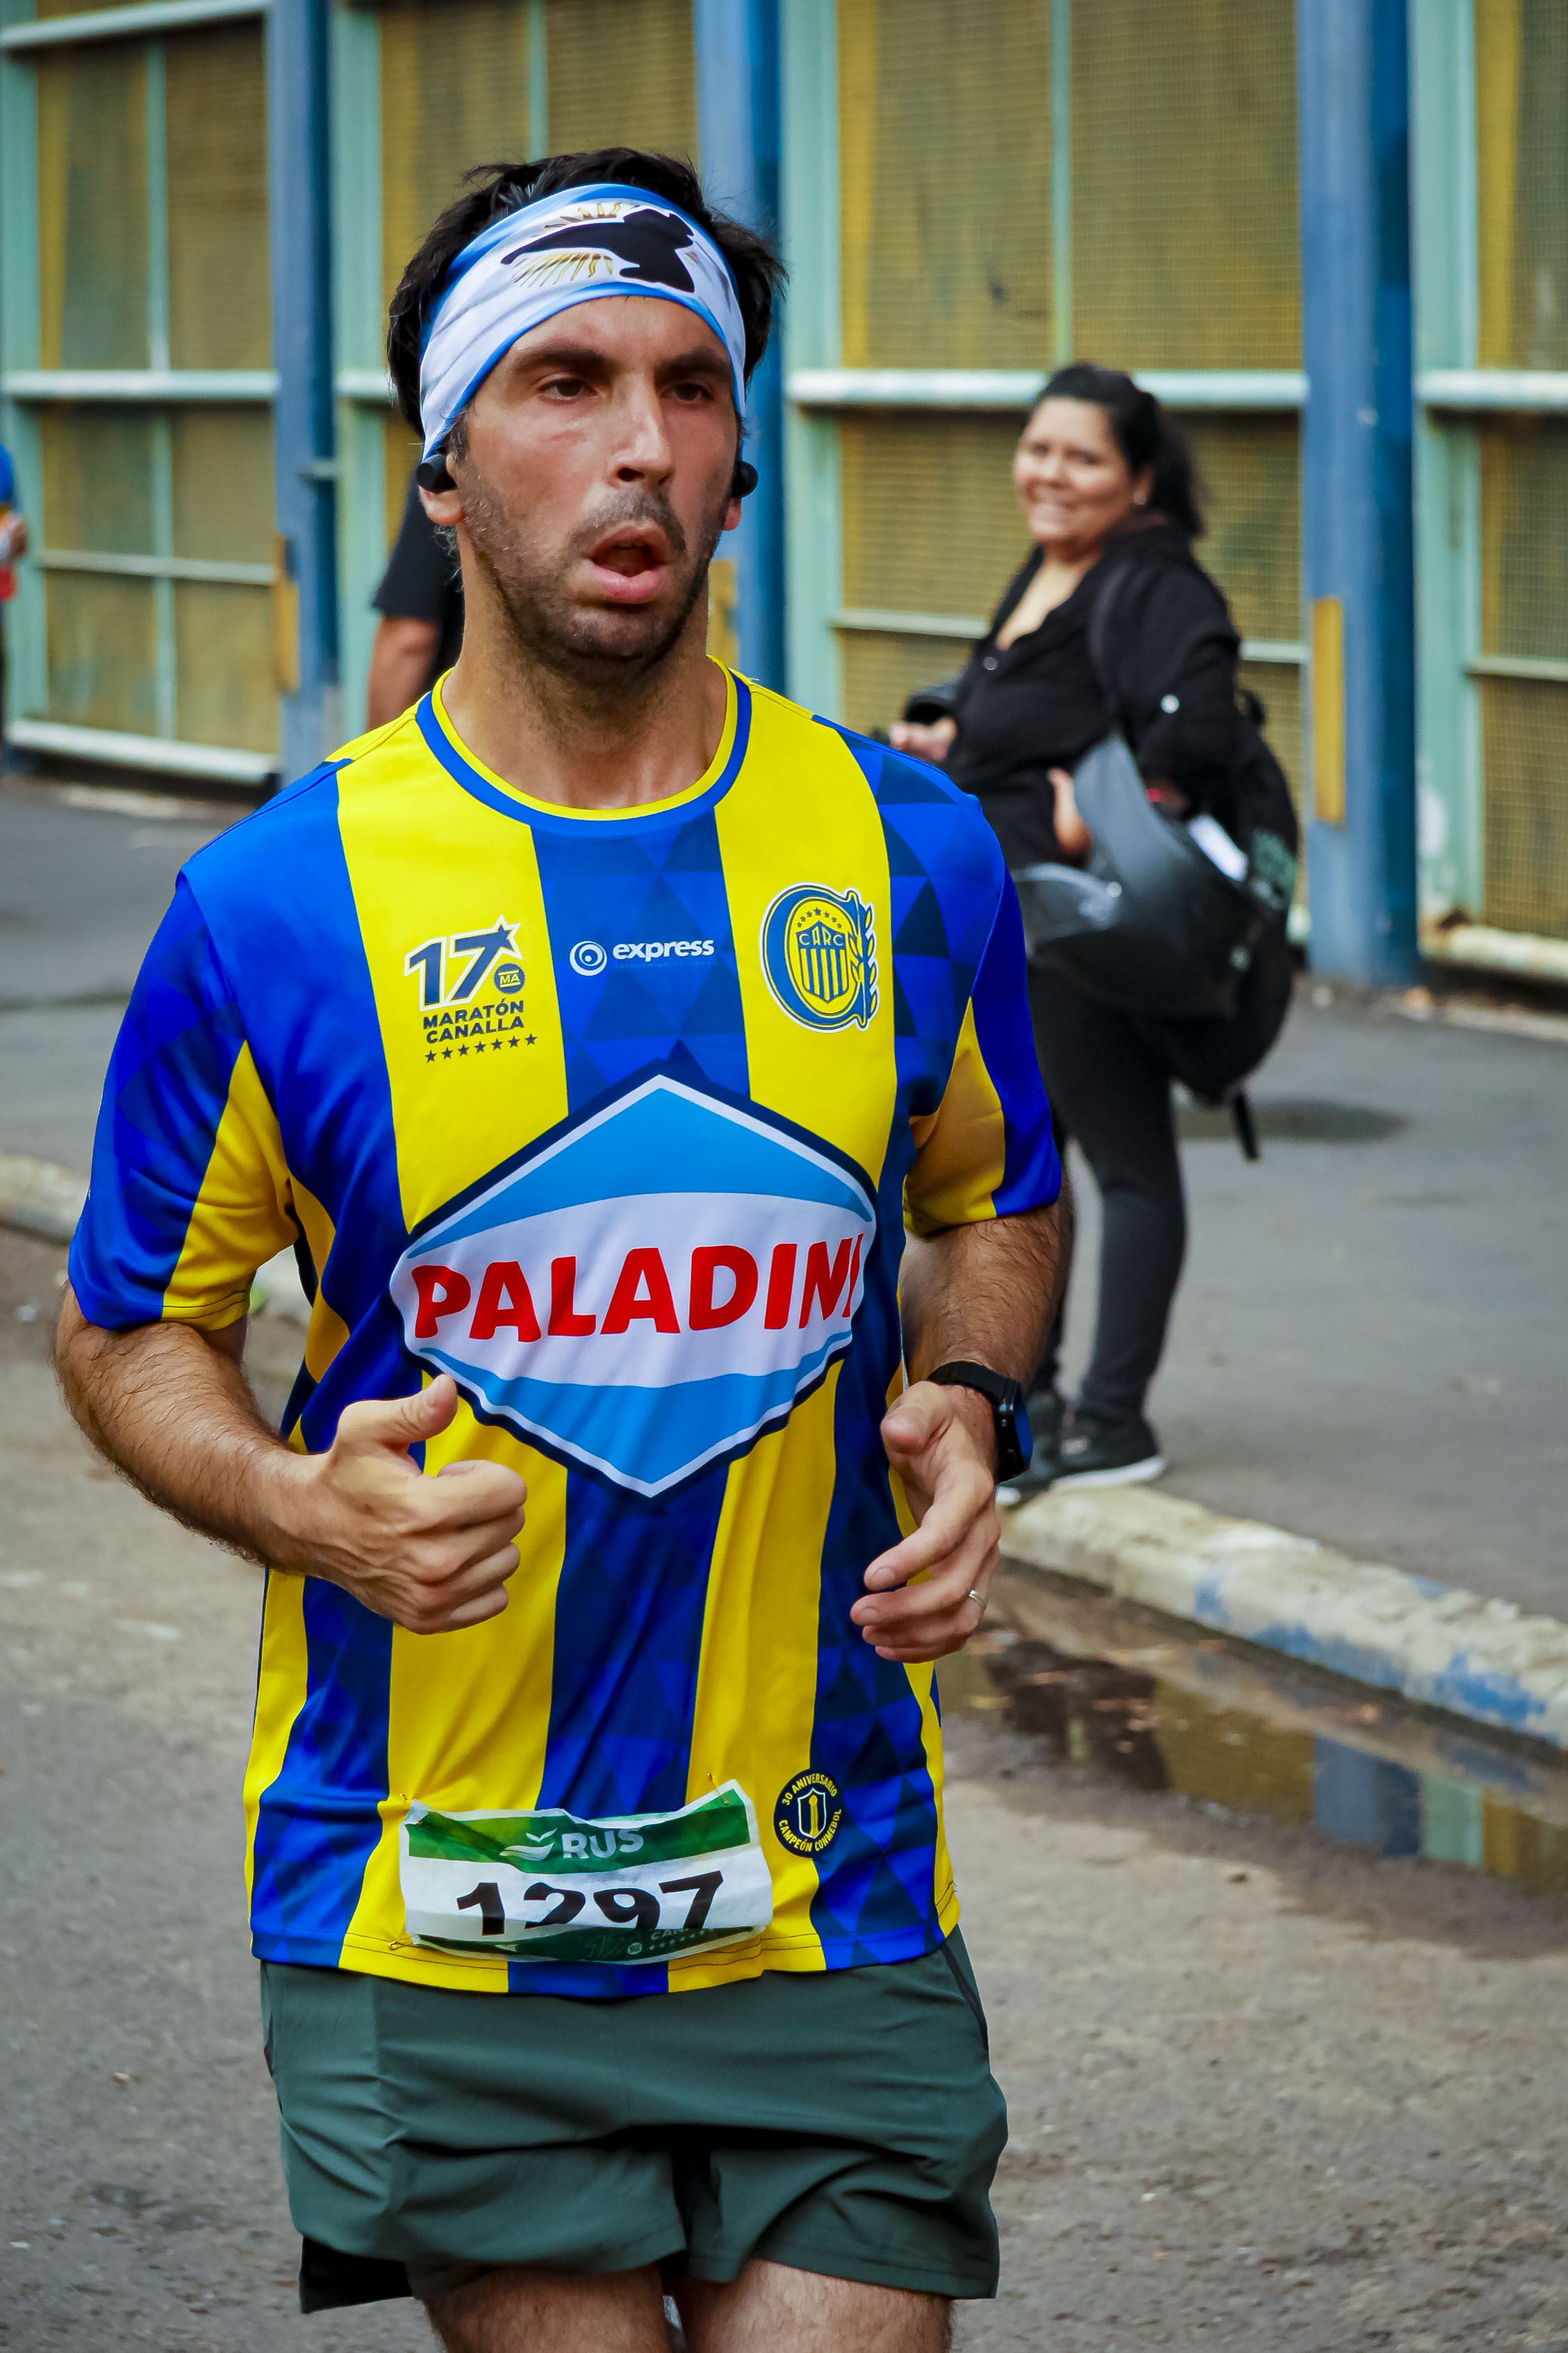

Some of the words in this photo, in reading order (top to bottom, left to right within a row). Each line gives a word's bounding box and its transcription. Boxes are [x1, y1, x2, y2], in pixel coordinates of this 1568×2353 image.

[613, 940, 715, 962] express
[799, 926, 843, 946] CARC
[500, 974, 520, 985] MA
[423, 999, 524, 1029] MARATÓN
[426, 1016, 524, 1044] CANALLA
[411, 1233, 864, 1343] PALADINI
[782, 1792, 793, 1805] 30
[792, 1773, 837, 1796] ANIVERSARIO
[561, 1828, 644, 1859] RUS
[779, 1819, 813, 1852] CAMPEÓN
[814, 1809, 841, 1851] CONMEBOL
[456, 1870, 724, 1936] 1297
